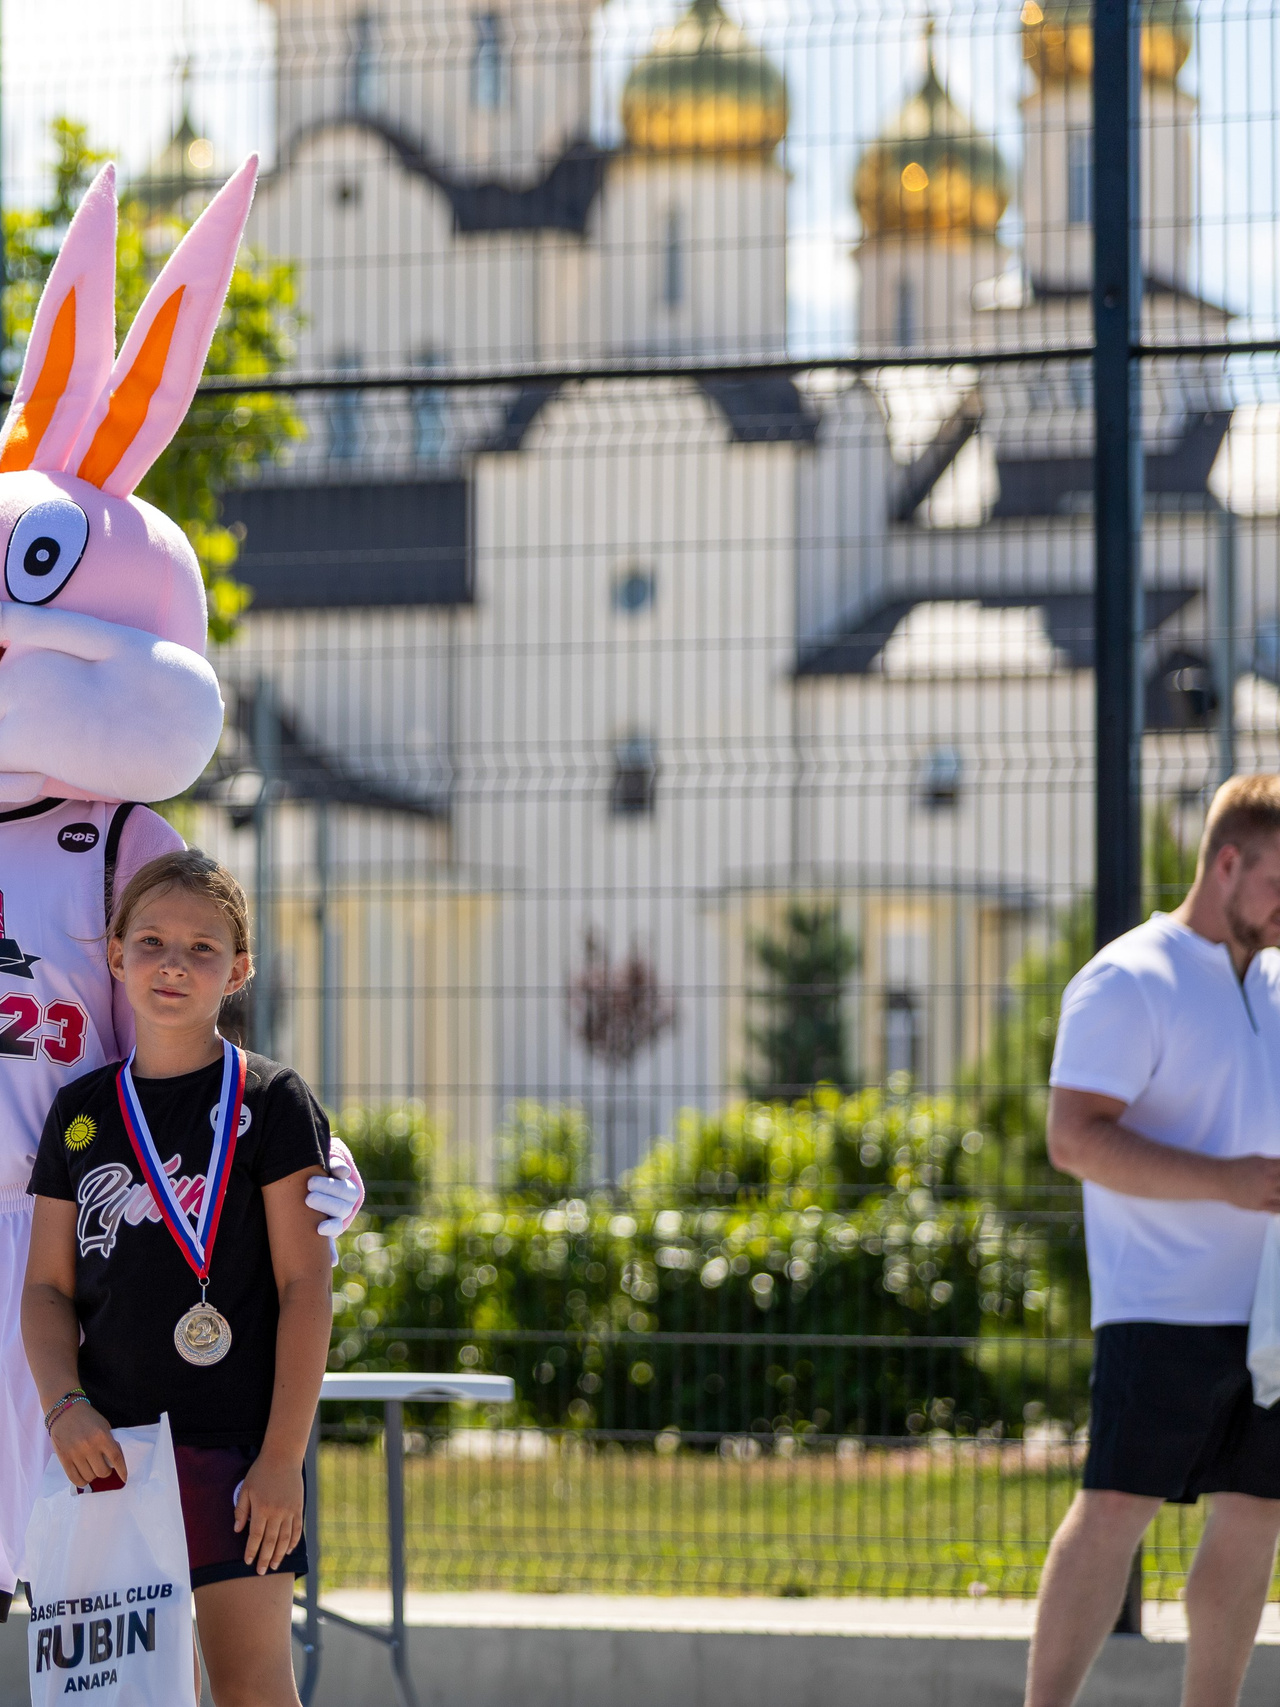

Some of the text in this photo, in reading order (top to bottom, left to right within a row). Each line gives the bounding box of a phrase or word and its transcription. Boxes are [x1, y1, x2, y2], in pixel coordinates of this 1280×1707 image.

[62, 831, 96, 844] РФБ
[194, 1320, 212, 1344] 2
[30, 1583, 173, 1622] BASKETBALL CLUB
[36, 1607, 156, 1674] RUBIN
[64, 1668, 118, 1694] ANAPA
